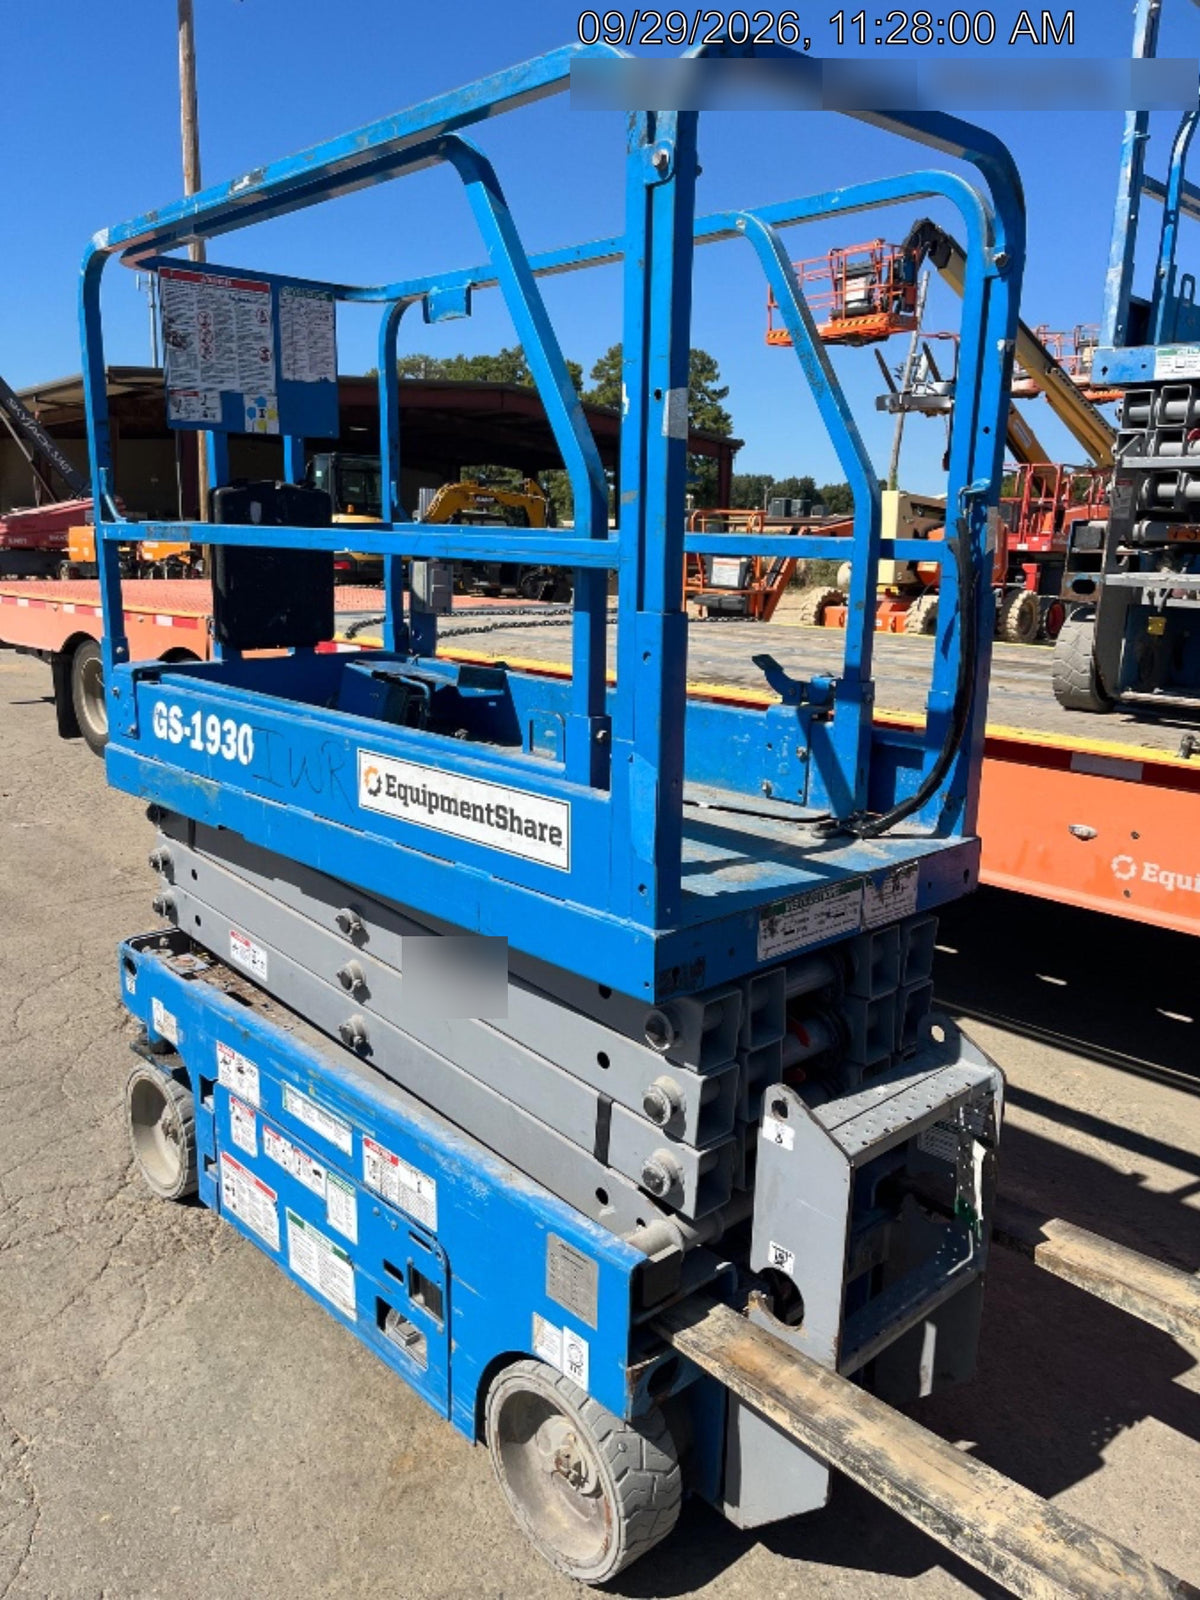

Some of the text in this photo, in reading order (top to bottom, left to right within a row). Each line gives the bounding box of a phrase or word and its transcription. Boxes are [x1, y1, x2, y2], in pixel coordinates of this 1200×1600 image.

[6, 397, 53, 453] SKYJACK
[153, 700, 255, 765] GS-1930
[385, 773, 563, 847] EquipmentShare
[1141, 861, 1200, 892] Equi
